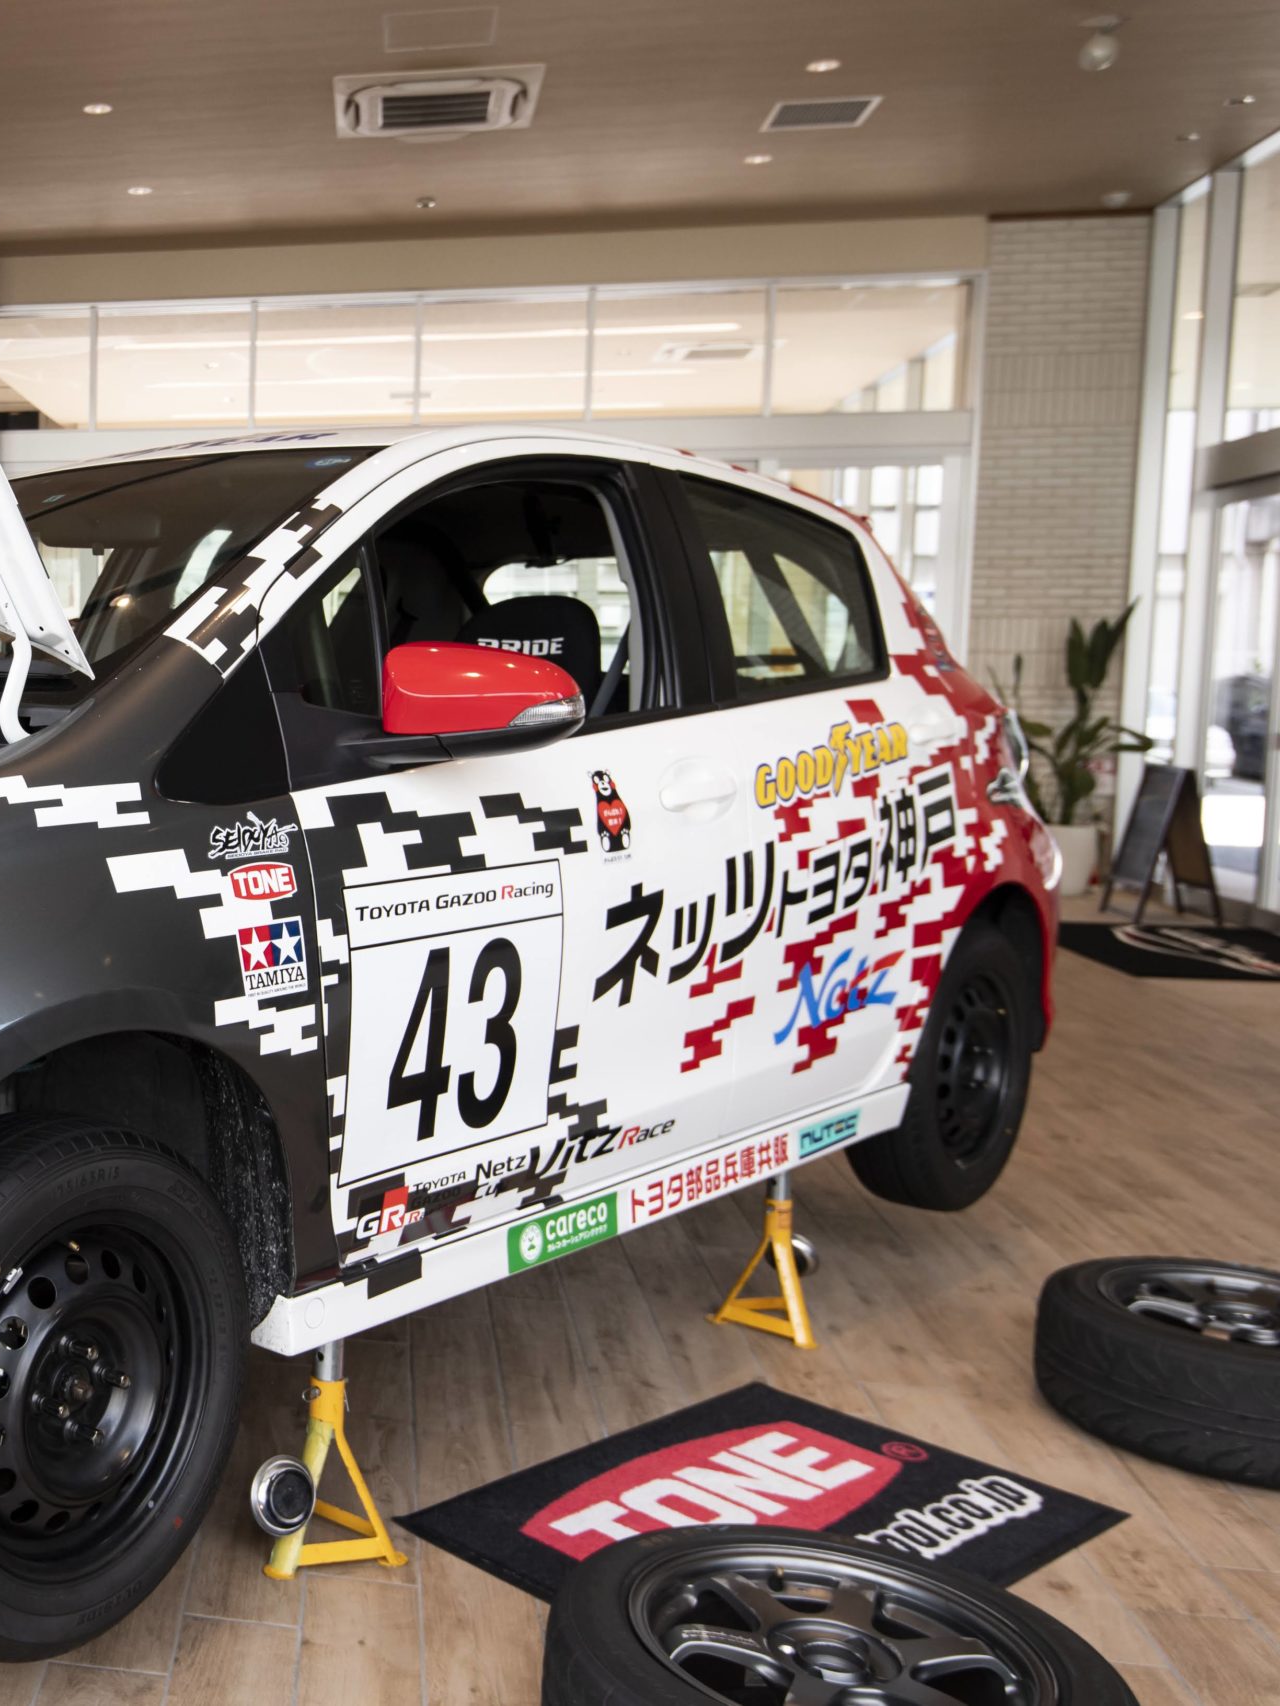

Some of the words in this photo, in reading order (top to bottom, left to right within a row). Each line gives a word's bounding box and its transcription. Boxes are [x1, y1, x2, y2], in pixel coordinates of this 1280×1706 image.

[754, 721, 909, 808] GOODYEAR
[233, 867, 293, 897] TONE
[355, 899, 430, 922] TOYOTA
[436, 889, 497, 910] GAZOO
[501, 881, 554, 900] Racing
[592, 762, 957, 1008] ネッツトヨタ神戸
[246, 966, 305, 990] TAMIYA
[773, 947, 905, 1045] Netz
[387, 937, 522, 1141] 43
[413, 1171, 466, 1193] TOYOTA
[475, 1154, 527, 1182] Netz
[356, 1203, 405, 1239] GR
[546, 1202, 608, 1240] careco
[549, 1430, 875, 1542] TONE
